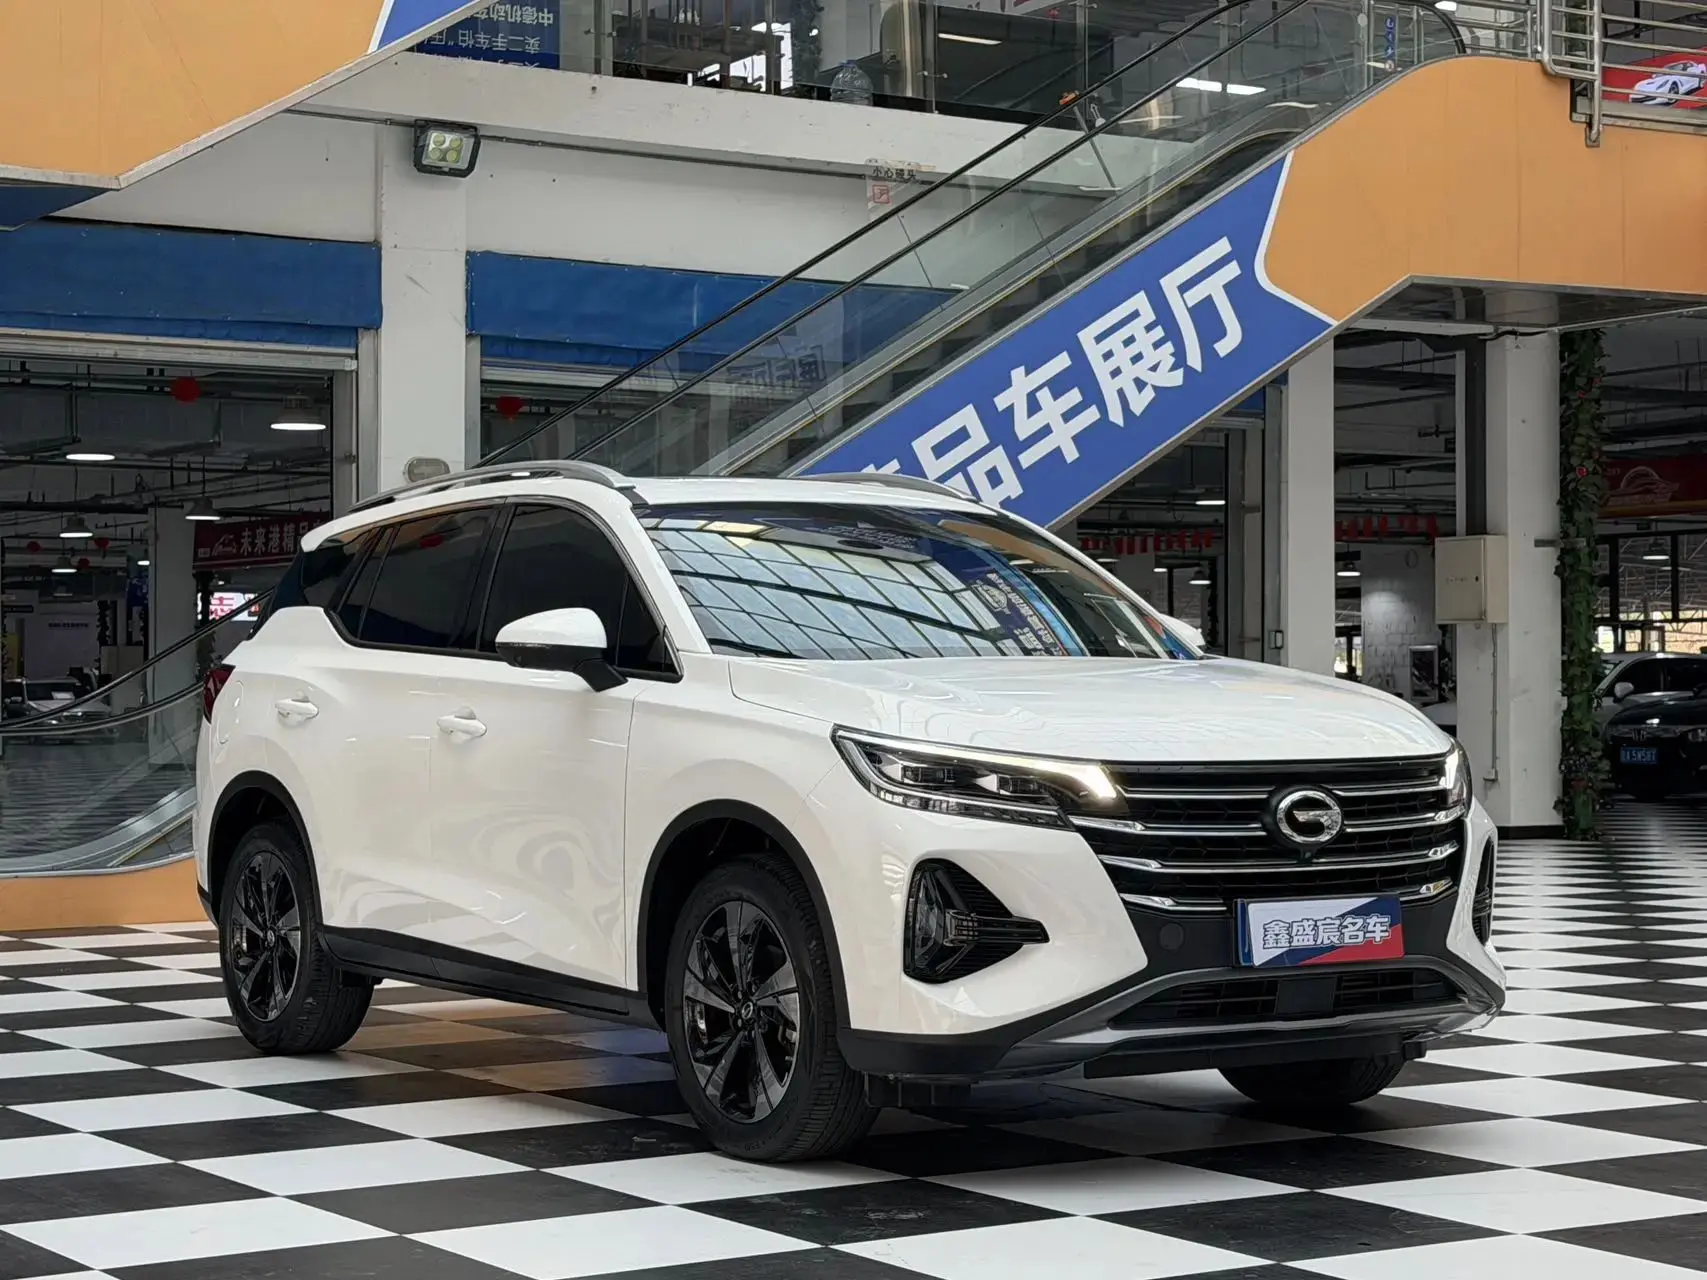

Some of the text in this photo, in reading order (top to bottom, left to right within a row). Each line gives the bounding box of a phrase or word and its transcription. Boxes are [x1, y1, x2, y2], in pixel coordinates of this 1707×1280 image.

[859, 235, 1243, 508] 品车展厅
[1262, 913, 1391, 950] 鑫盛宸名车
